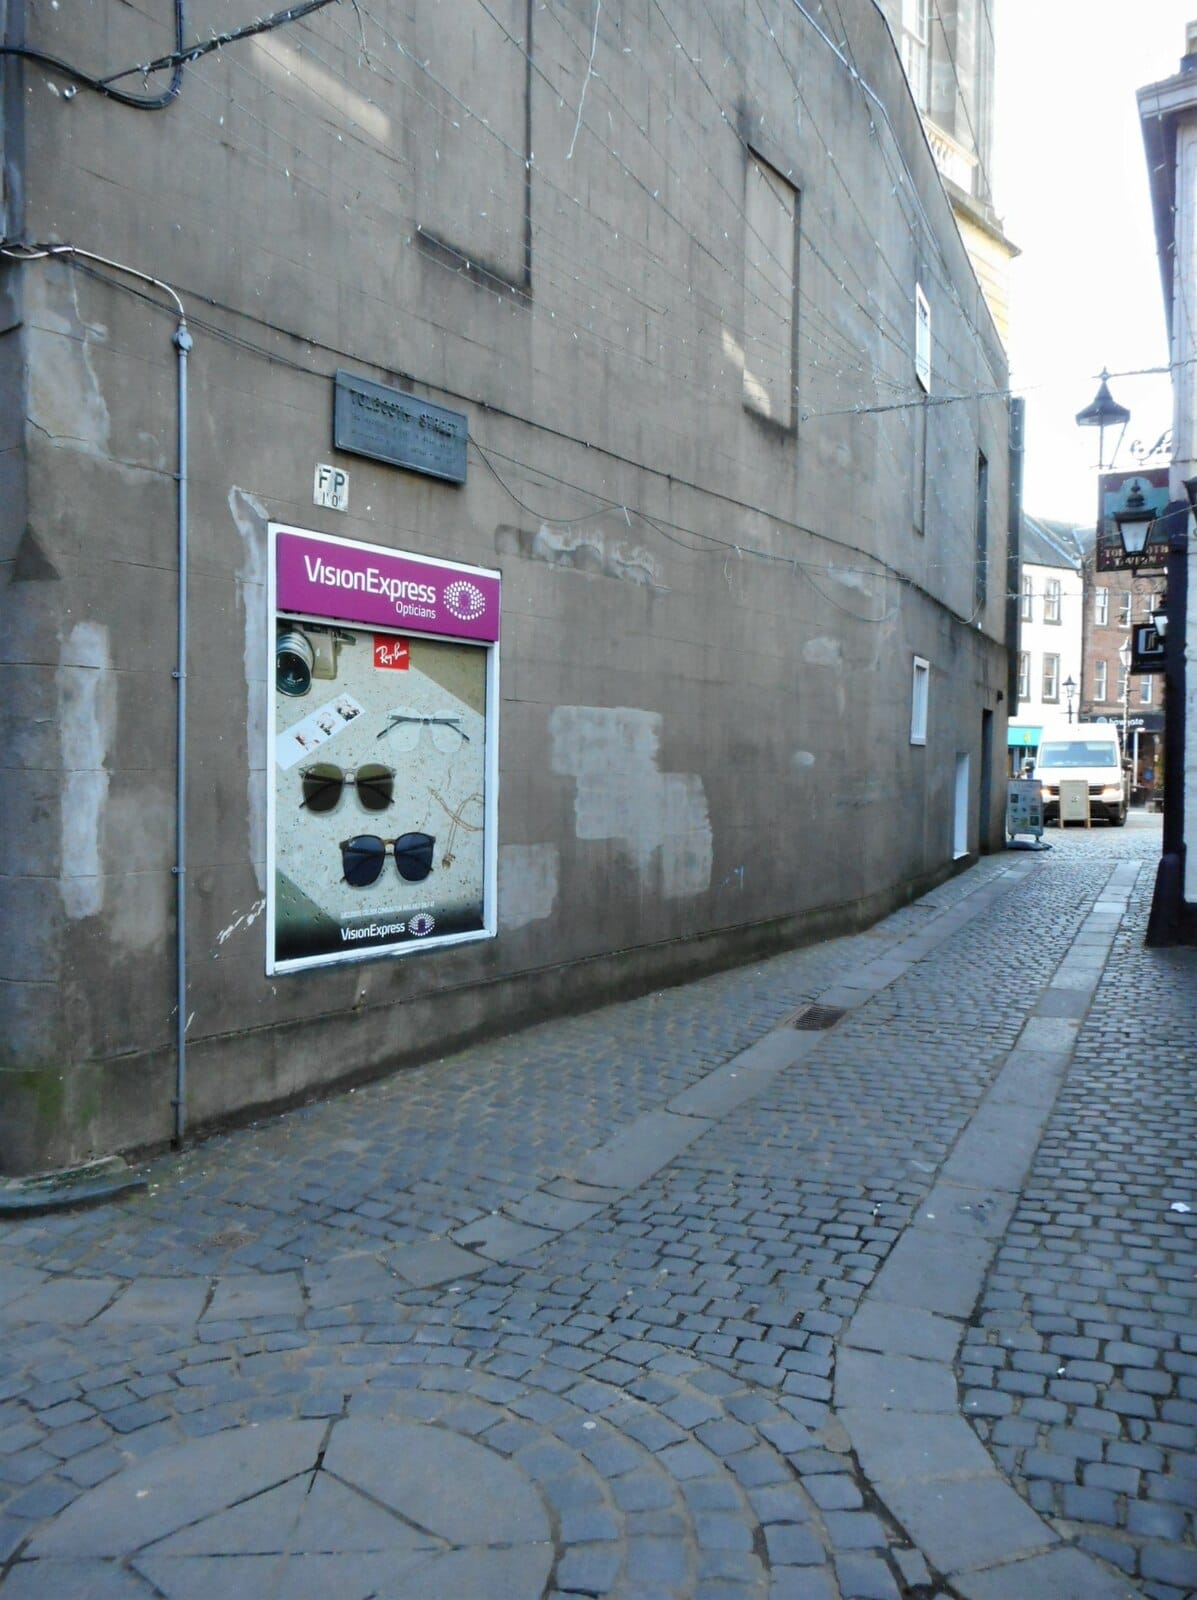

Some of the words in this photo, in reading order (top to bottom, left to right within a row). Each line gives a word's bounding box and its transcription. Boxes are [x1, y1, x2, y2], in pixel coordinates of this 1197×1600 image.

[1104, 545, 1169, 558] TOLOTH
[304, 555, 436, 603] VisionExpress
[395, 600, 437, 619] Opticians
[341, 923, 405, 940] VisionExpress
